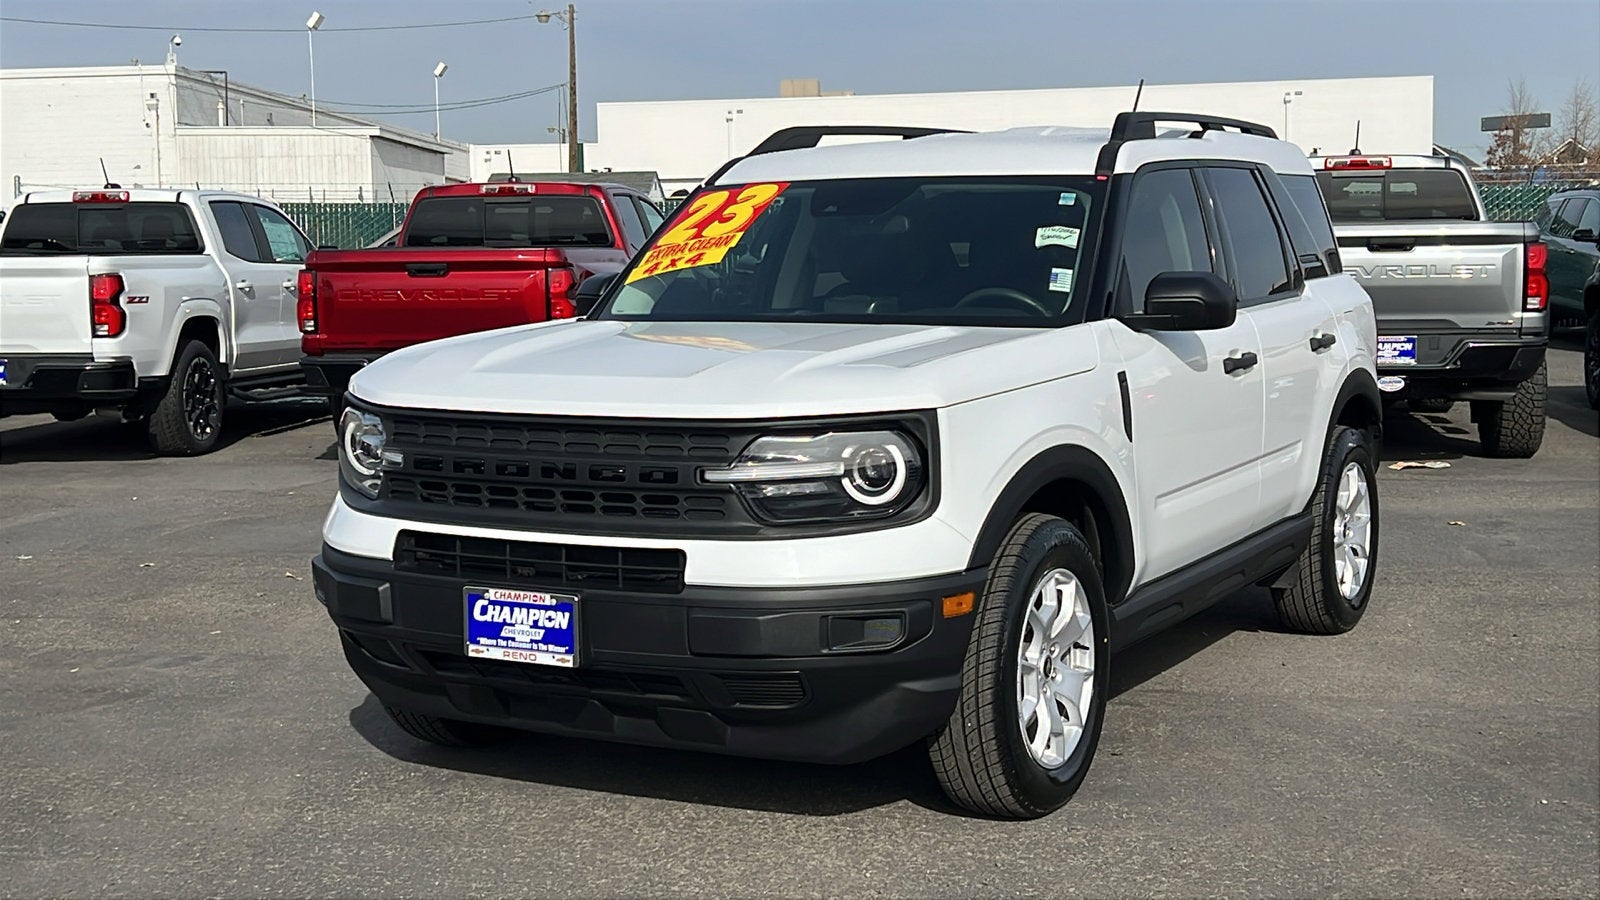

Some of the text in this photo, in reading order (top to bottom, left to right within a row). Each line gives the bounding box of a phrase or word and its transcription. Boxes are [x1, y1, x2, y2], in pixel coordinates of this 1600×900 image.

[656, 183, 779, 247] 23
[645, 234, 736, 264] EXTRA CLEAN
[1342, 264, 1497, 279] EVROLET
[338, 288, 520, 302] CHEVROLET
[413, 454, 679, 484] BRONCO
[493, 591, 546, 603] CHAMPION
[473, 599, 570, 630] CHAMPION
[503, 628, 541, 637] CHEVROLET
[502, 651, 537, 662] RENO
